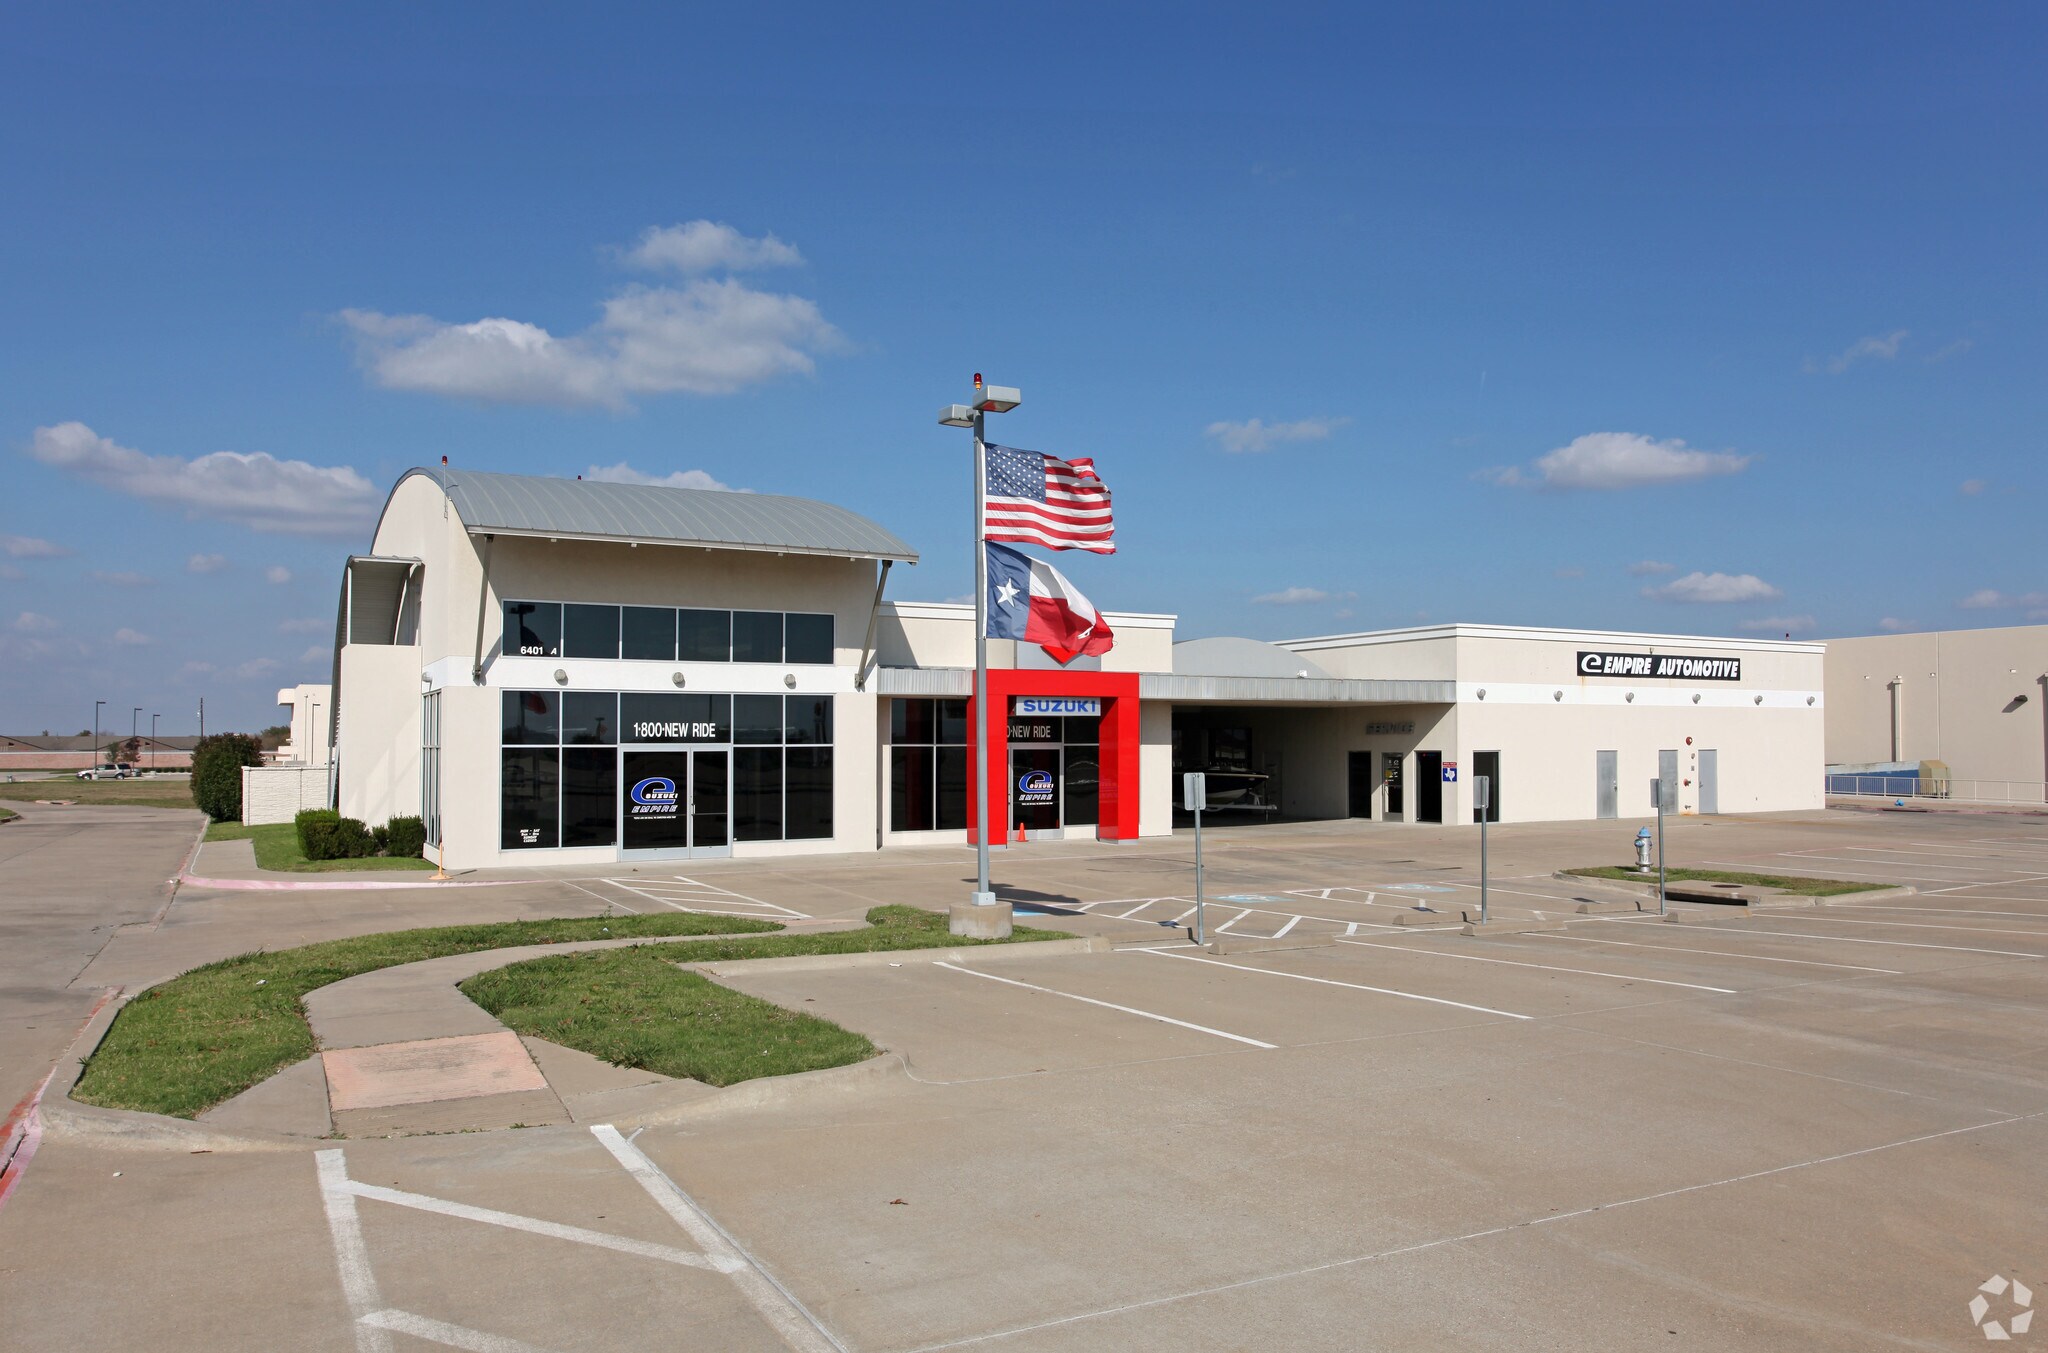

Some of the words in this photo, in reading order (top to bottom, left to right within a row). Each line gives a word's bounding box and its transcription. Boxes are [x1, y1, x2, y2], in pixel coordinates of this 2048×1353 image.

[520, 646, 543, 655] 6401
[550, 647, 557, 655] A
[1603, 656, 1652, 675] EMPIRE
[1657, 658, 1739, 678] AUTOMOTIVE
[1023, 699, 1096, 712] SUZUKI
[692, 722, 716, 738] RIDE
[1033, 725, 1051, 738] RIDE
